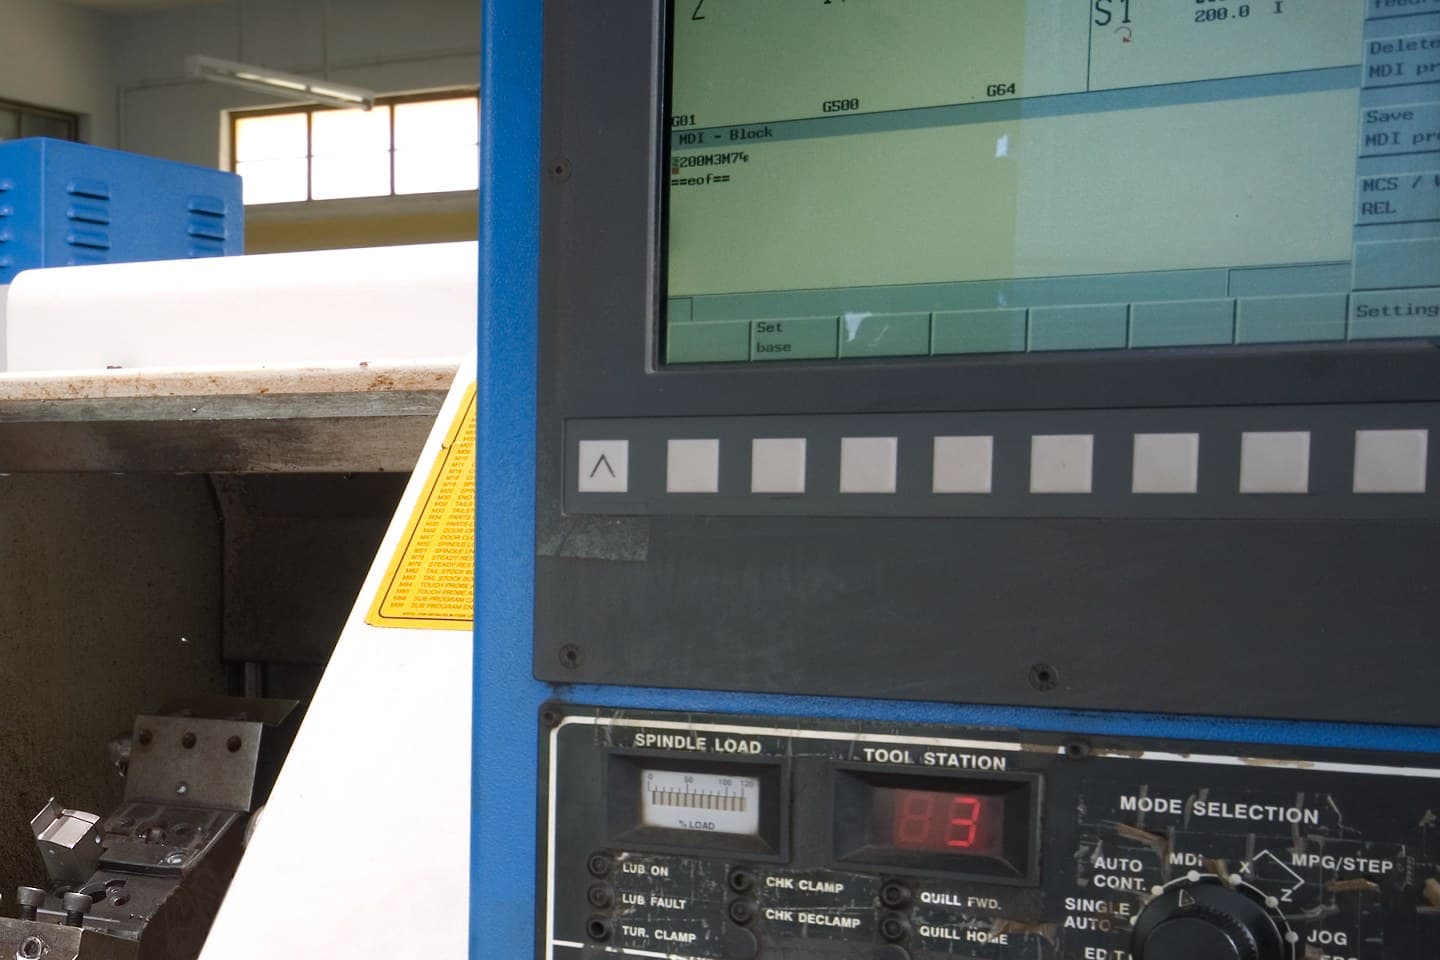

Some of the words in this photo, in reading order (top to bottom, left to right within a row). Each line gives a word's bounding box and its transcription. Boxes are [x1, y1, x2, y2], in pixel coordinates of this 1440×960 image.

[1194, 5, 1251, 24] 200.0
[1368, 62, 1406, 78] MDI
[986, 82, 1016, 97] G64
[822, 98, 860, 113] G500
[1366, 109, 1415, 124] Save
[679, 131, 705, 145] MDI
[729, 126, 774, 141] Block
[1365, 131, 1401, 147] MDI
[1361, 200, 1397, 216] REL
[756, 320, 784, 334] Set
[756, 341, 792, 354] base
[633, 733, 707, 751] SPINDLE
[715, 738, 762, 754] LOAD
[863, 747, 914, 765] TOOL
[923, 752, 1006, 771] STATION
[718, 779, 733, 787] 100
[1120, 795, 1183, 815] MODE
[1193, 799, 1320, 825] SELECTION
[689, 820, 716, 830] LOAD
[622, 863, 646, 875] LUB
[651, 866, 669, 877] ON
[1093, 856, 1143, 873] AUTO
[1239, 860, 1251, 875] X
[1291, 853, 1394, 875] MPG/STEP
[766, 876, 794, 889] CHK
[799, 879, 844, 894] CLAMP
[1093, 873, 1147, 892] CONT.
[622, 893, 645, 905] LUB
[650, 895, 686, 910] FAULT
[920, 891, 962, 907] QUILL
[967, 896, 1002, 910] FWD.
[1281, 888, 1293, 903] Z
[765, 909, 793, 922] CHK
[798, 912, 861, 929] DECLAMP
[622, 925, 649, 938] TUR.
[654, 929, 696, 943] CLAMP
[919, 926, 961, 941] QUILL
[966, 930, 1008, 945] HOME
[1307, 930, 1348, 947] JOG
